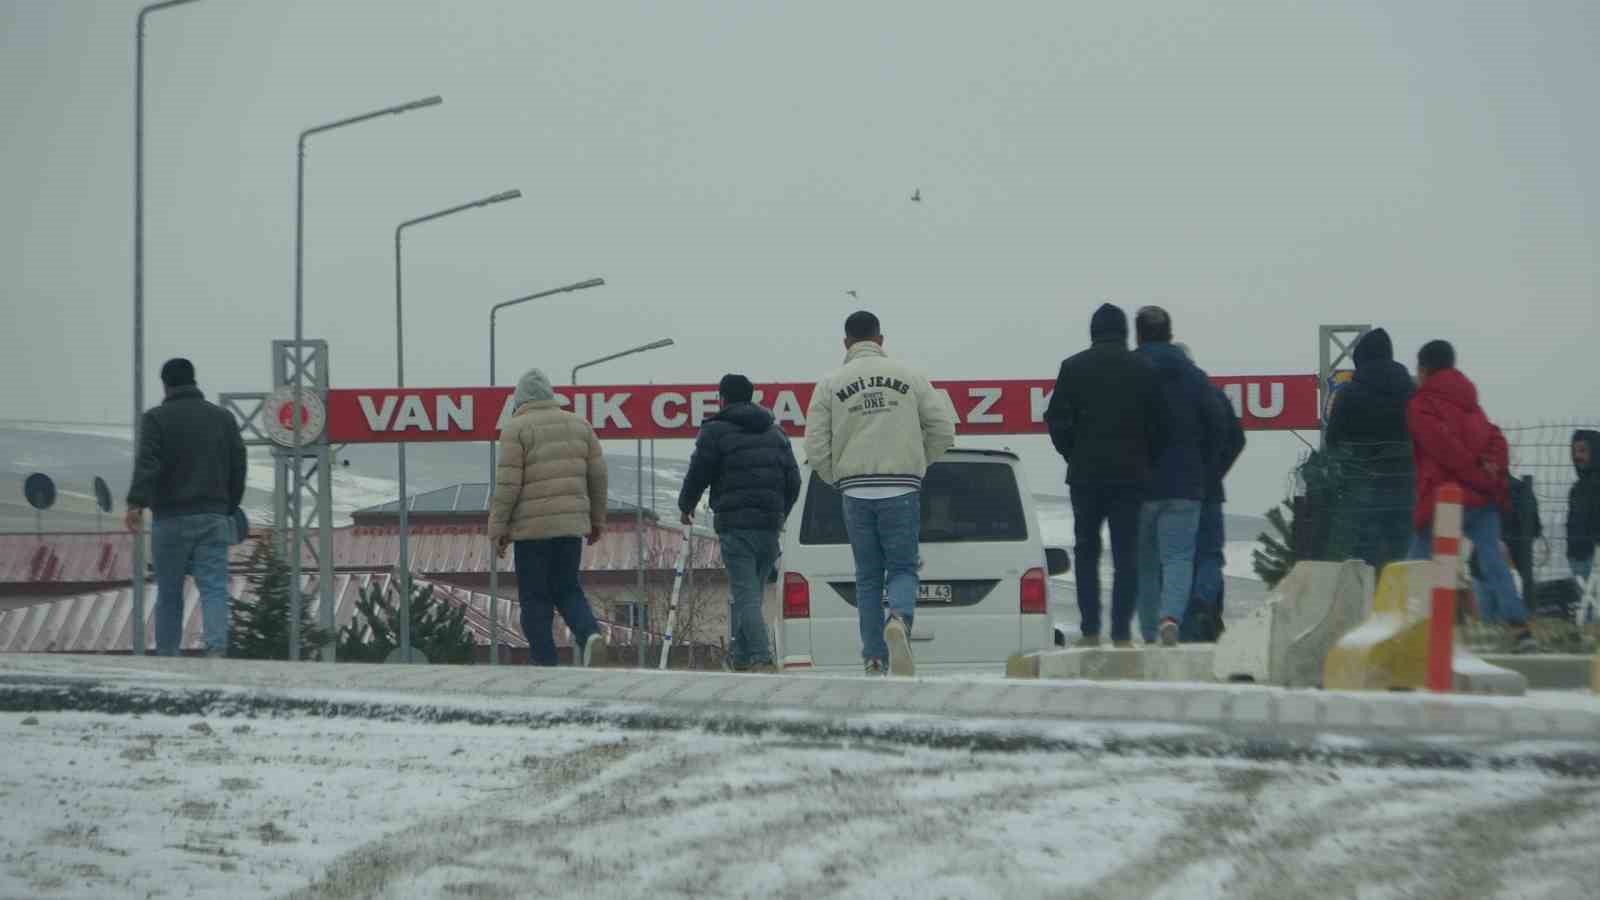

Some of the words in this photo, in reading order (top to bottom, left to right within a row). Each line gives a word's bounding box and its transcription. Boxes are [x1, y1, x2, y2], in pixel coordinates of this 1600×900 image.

[867, 376, 910, 395] JEANS
[358, 395, 474, 431] VAN
[651, 390, 808, 429] CEA
